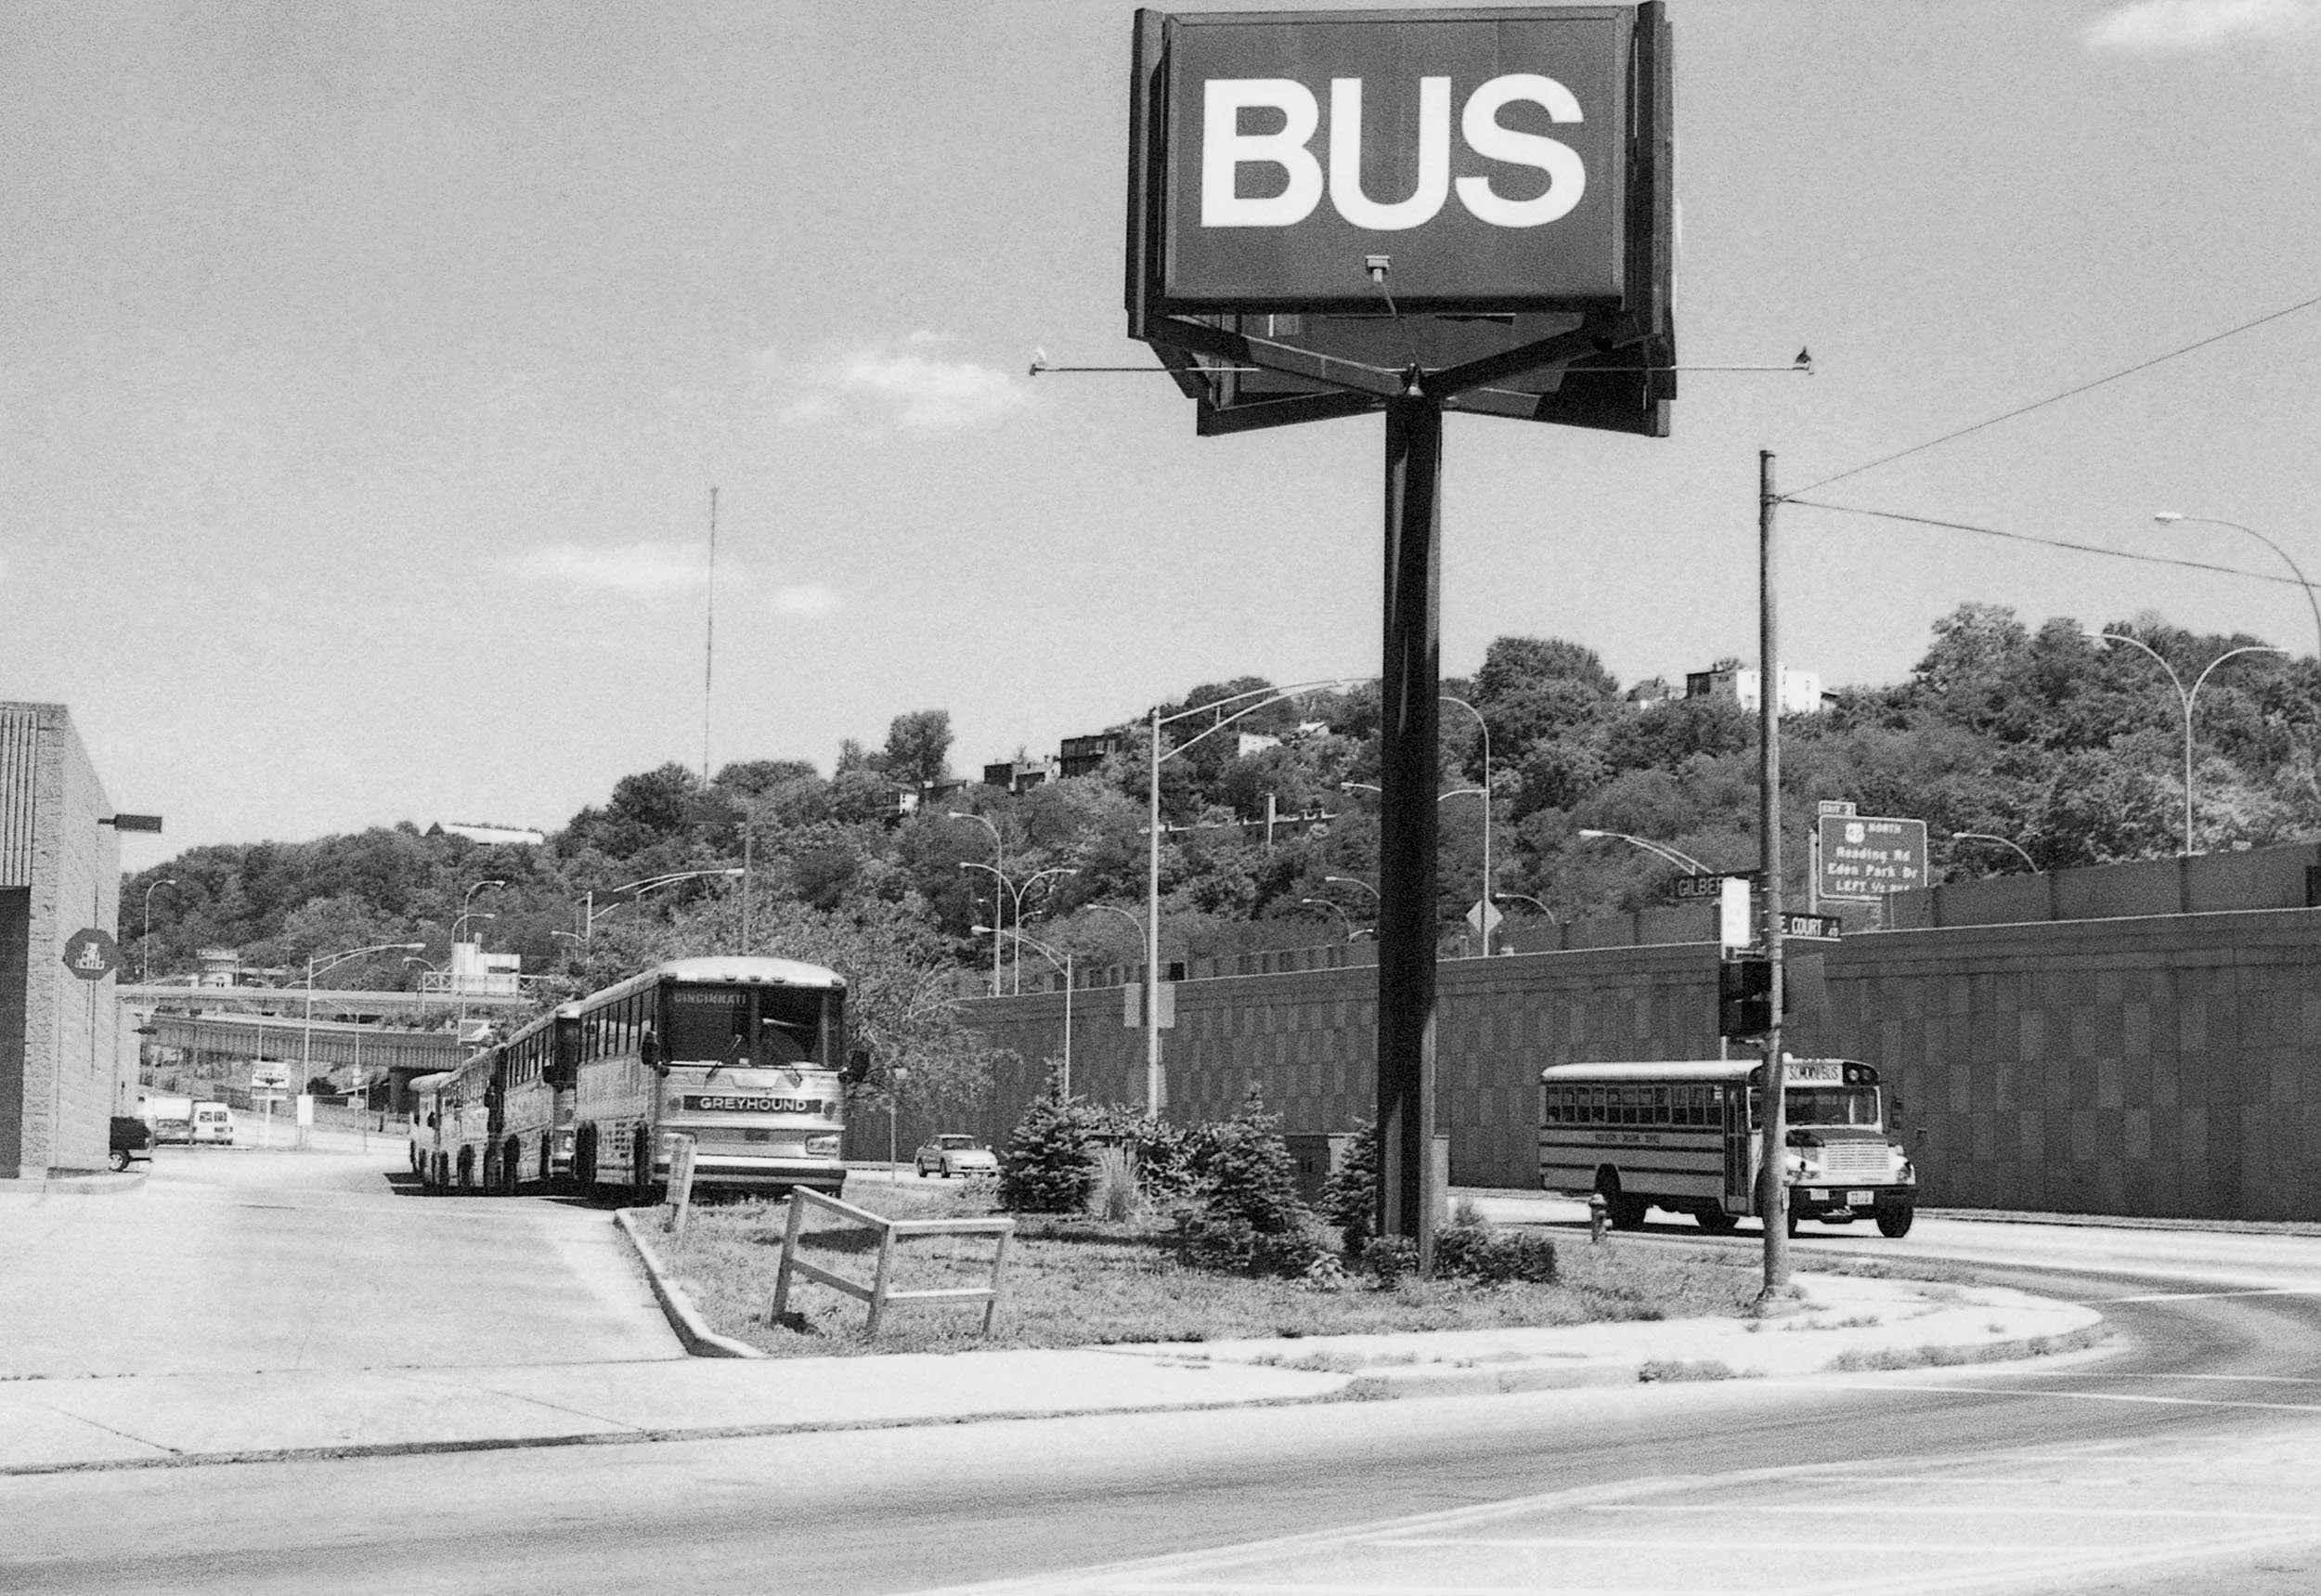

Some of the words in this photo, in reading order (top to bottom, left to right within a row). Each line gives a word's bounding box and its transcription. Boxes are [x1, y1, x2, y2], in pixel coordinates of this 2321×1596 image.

[1201, 74, 1586, 230] BUS
[1868, 823, 1902, 834] NORTH
[1836, 846, 1887, 864] Reading
[1894, 849, 1911, 863] Rd
[1827, 862, 1860, 876] Eden
[1866, 863, 1896, 877] Park
[1902, 865, 1918, 879] Dr
[1835, 879, 1867, 892] LEFT
[1791, 916, 1822, 937] COURT
[673, 993, 746, 1006] CINCINNATI
[1788, 1064, 1822, 1081] SCHOOL
[1822, 1064, 1839, 1081] BUS
[700, 1096, 807, 1112] GREYHOUND
